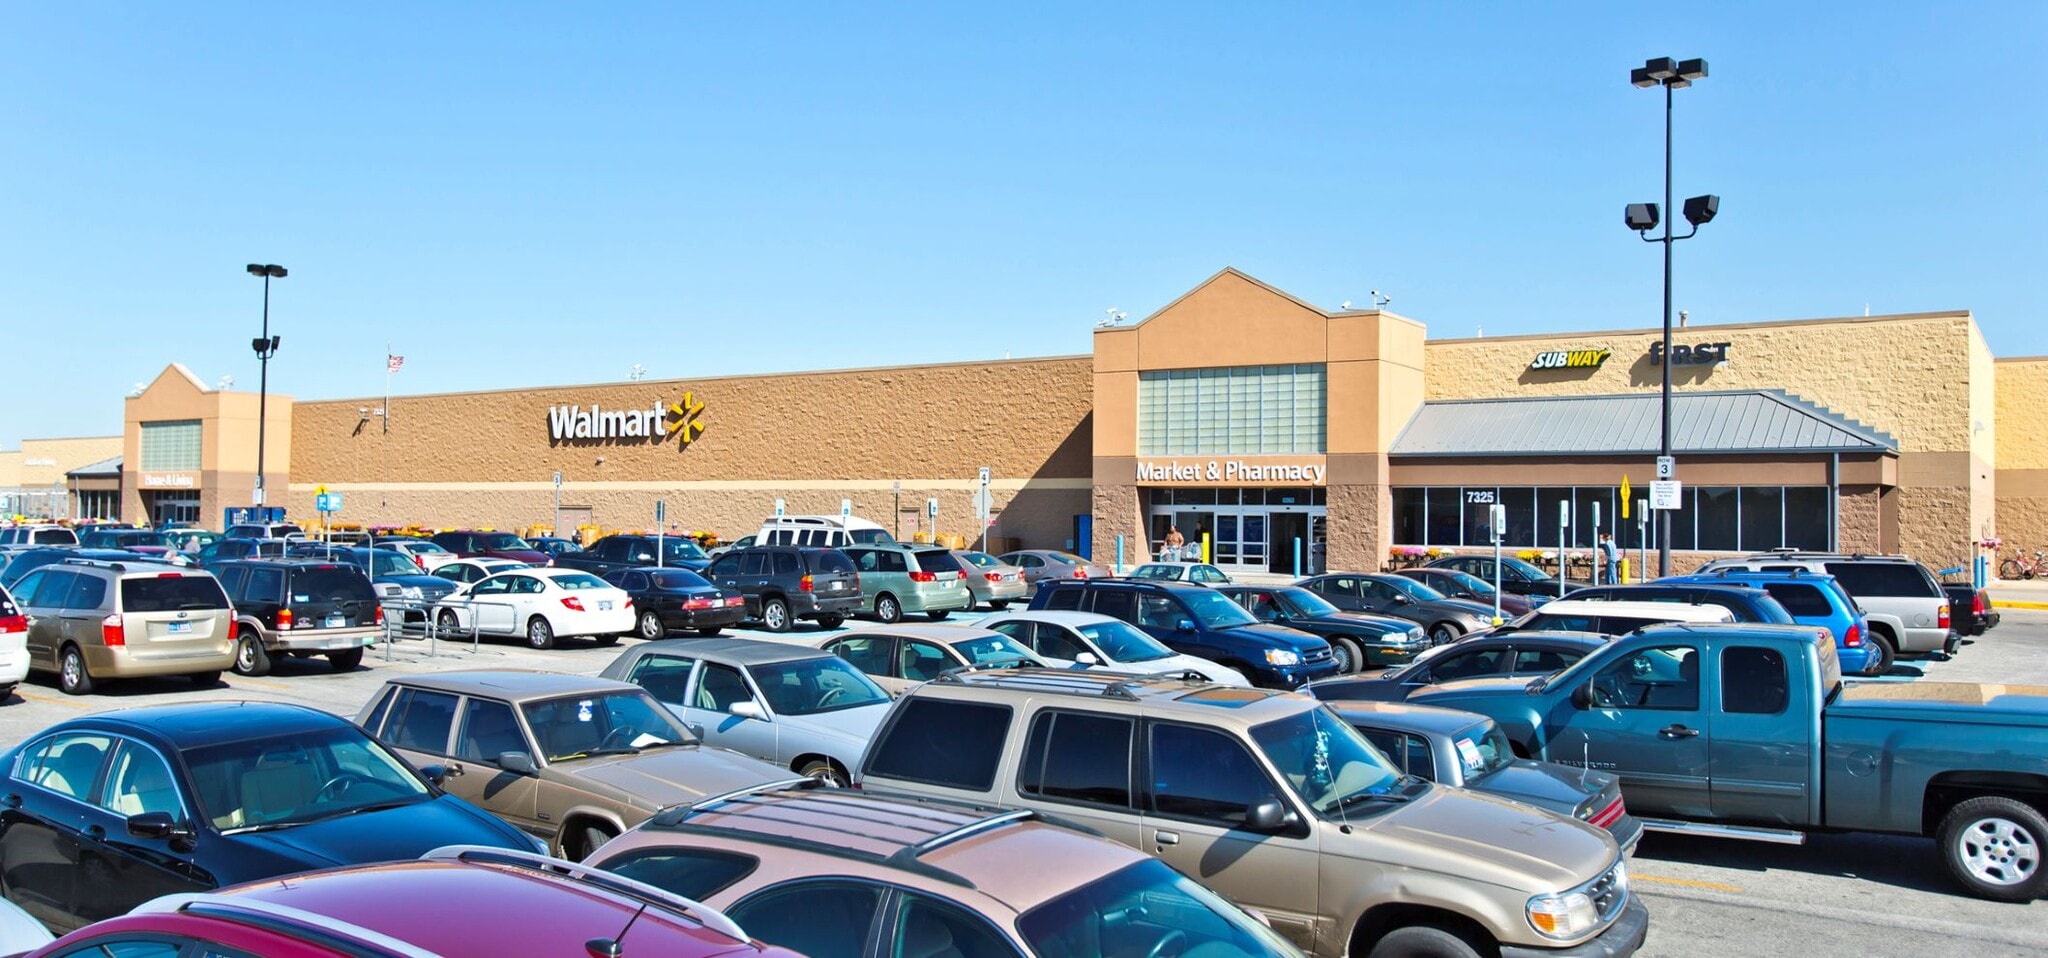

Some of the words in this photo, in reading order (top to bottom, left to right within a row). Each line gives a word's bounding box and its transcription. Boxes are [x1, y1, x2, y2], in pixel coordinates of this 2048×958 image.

[1532, 349, 1609, 369] SUBWAY
[1649, 341, 1731, 365] fRST
[549, 400, 666, 439] Walmart
[1136, 462, 1201, 481] Market
[1206, 461, 1220, 480] &
[1225, 463, 1326, 485] Pharmacy
[1660, 464, 1668, 474] 3
[1466, 491, 1494, 503] 7325
